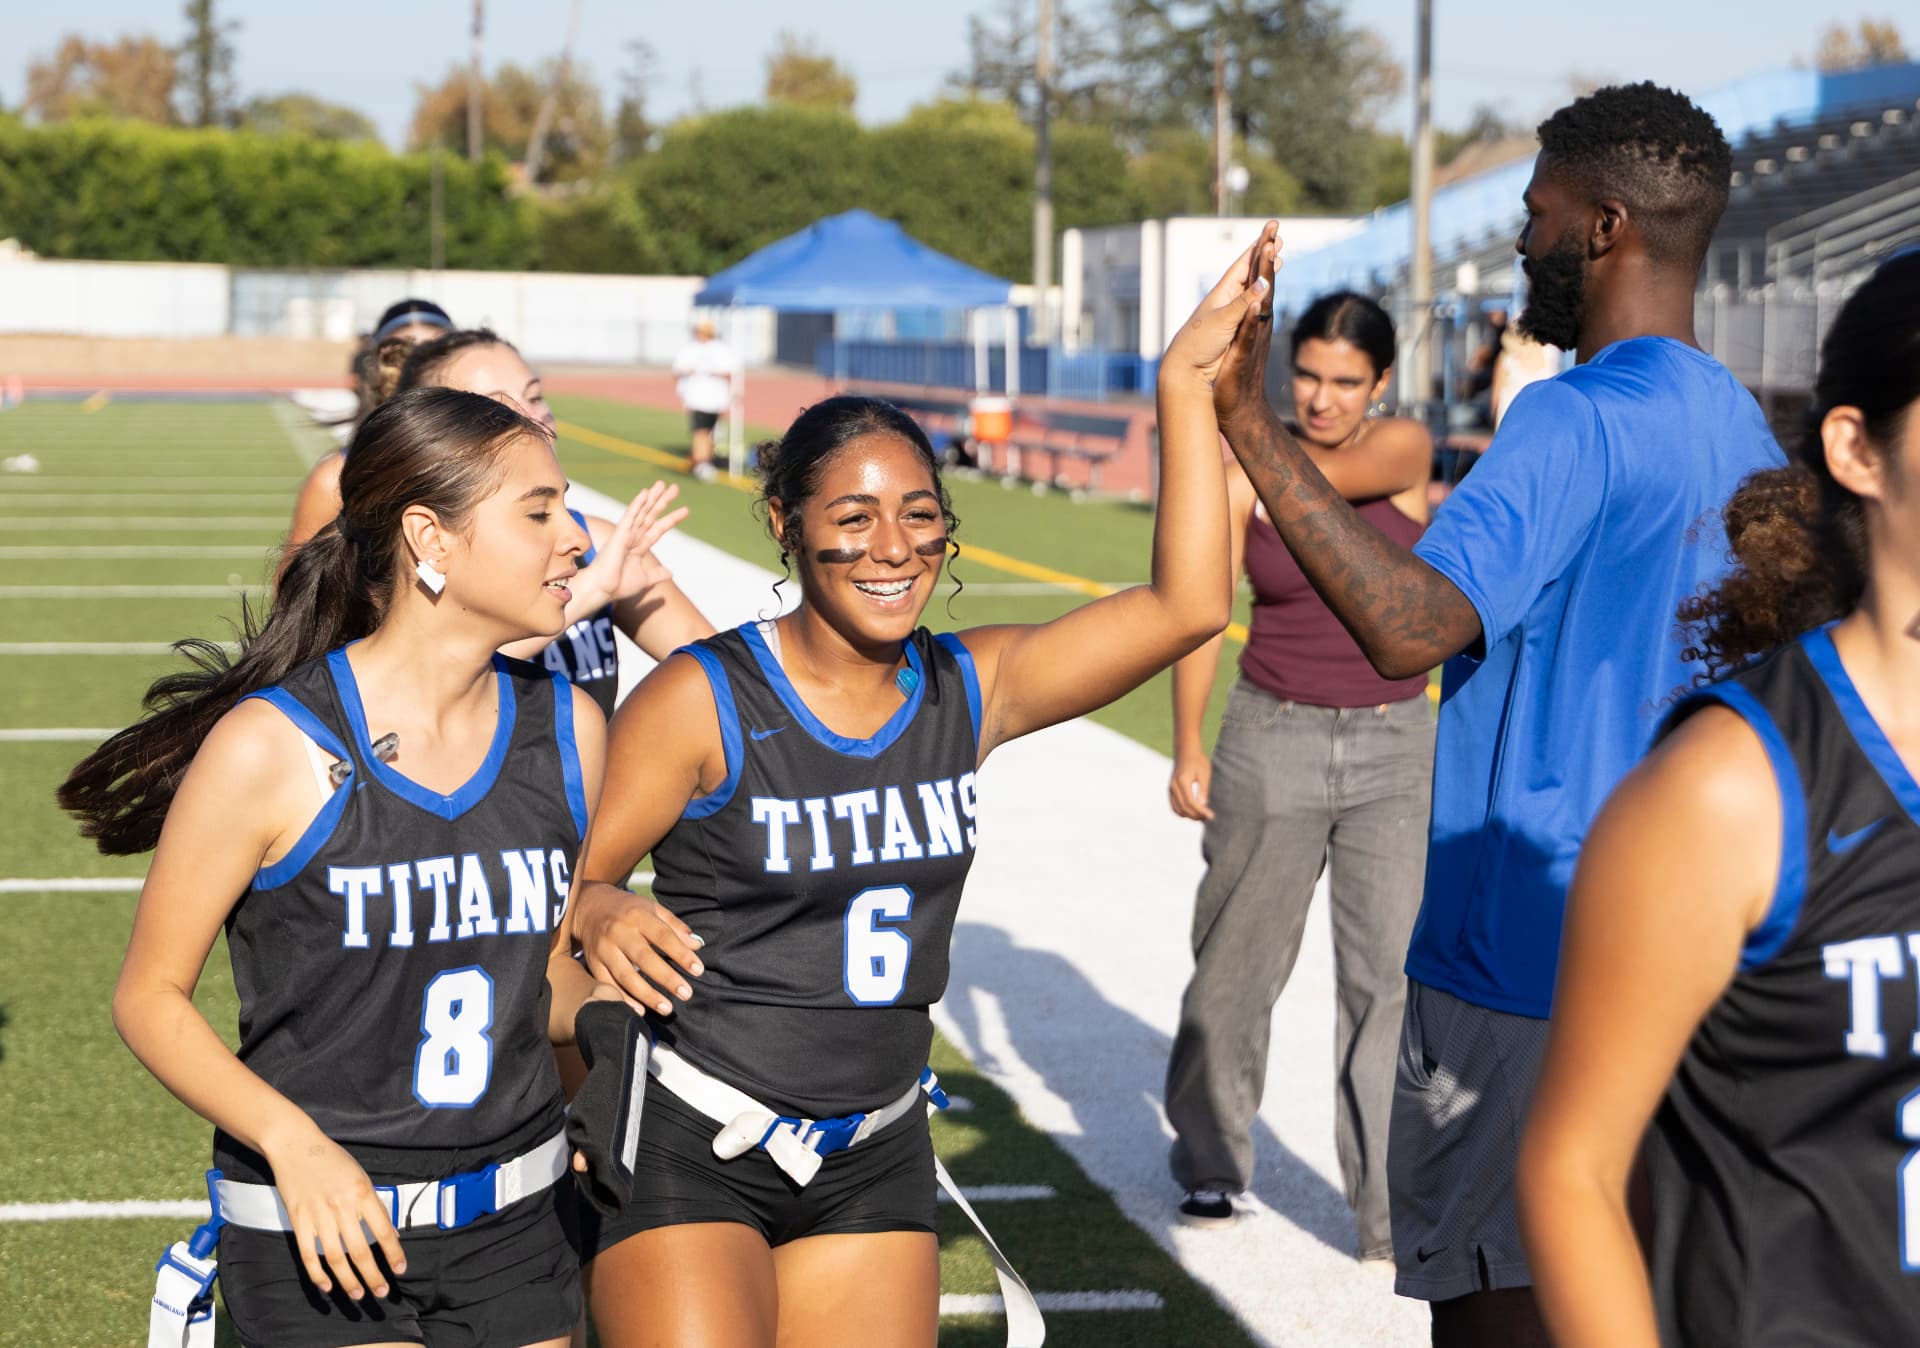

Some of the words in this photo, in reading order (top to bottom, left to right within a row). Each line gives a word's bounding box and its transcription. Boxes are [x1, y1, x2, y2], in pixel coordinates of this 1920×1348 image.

[541, 617, 616, 682] ANS
[751, 771, 976, 873] TITANS
[327, 848, 569, 948] TITANS
[843, 883, 915, 1006] 6
[412, 964, 494, 1108] 8
